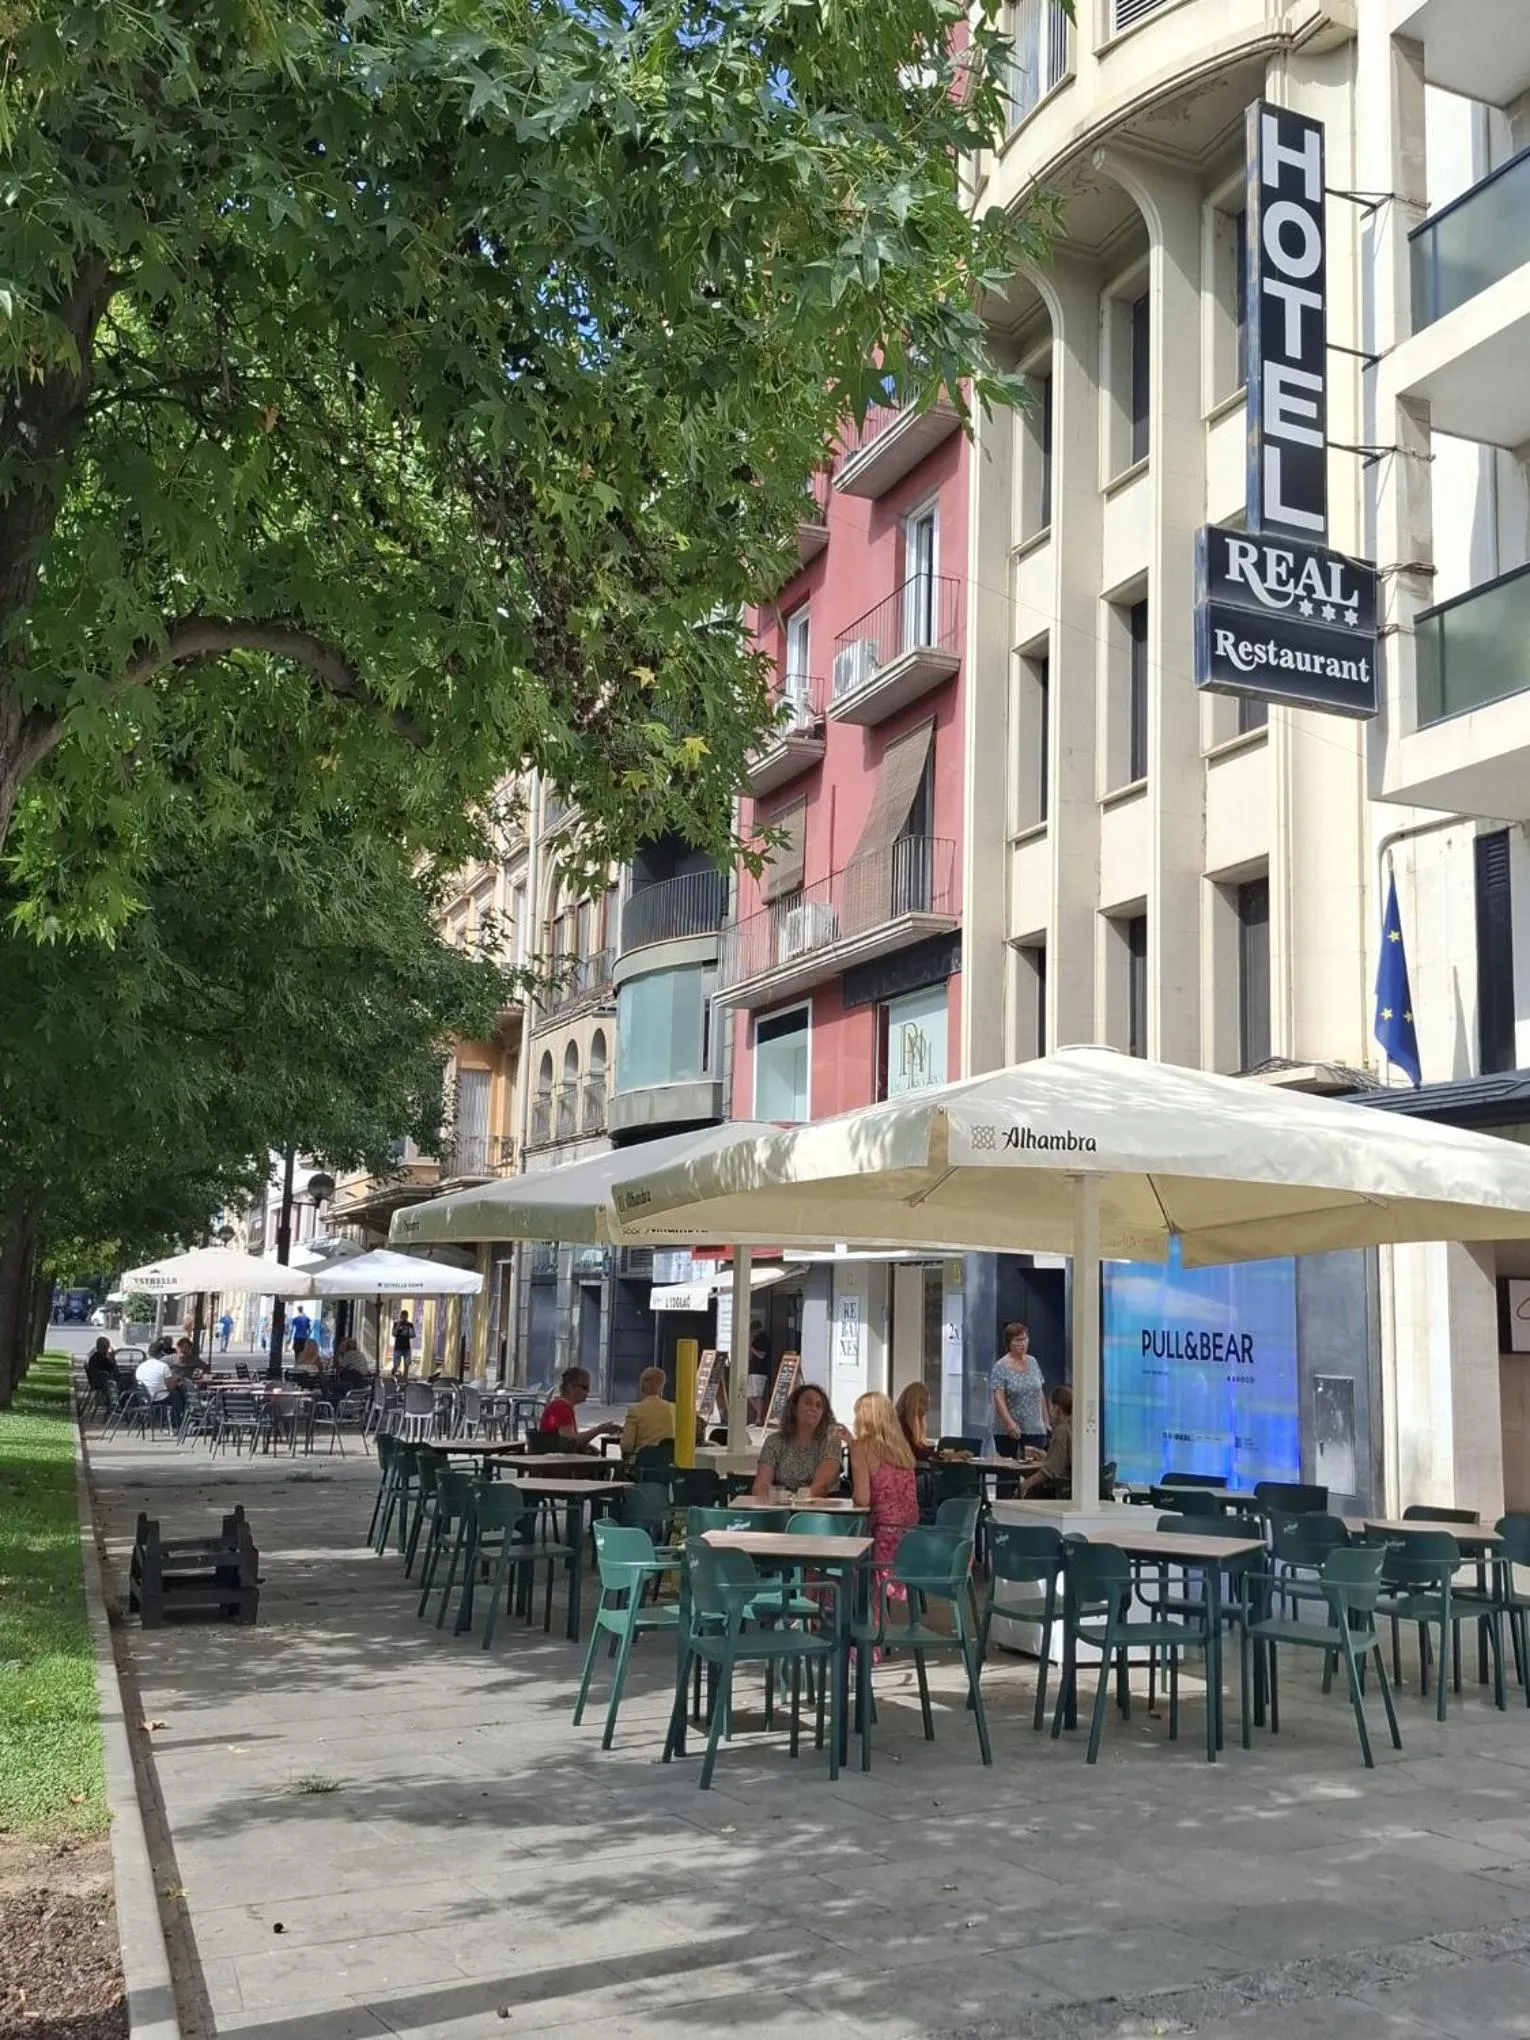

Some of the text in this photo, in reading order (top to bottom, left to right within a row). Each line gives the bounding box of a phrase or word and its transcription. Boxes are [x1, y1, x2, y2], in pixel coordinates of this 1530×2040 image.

[1261, 113, 1324, 532] HOTEL
[1224, 537, 1359, 608] REAL
[1214, 628, 1370, 683] Restaurant
[1001, 1126, 1097, 1152] Alhambra
[1142, 1329, 1254, 1364] PULL&BEAR
